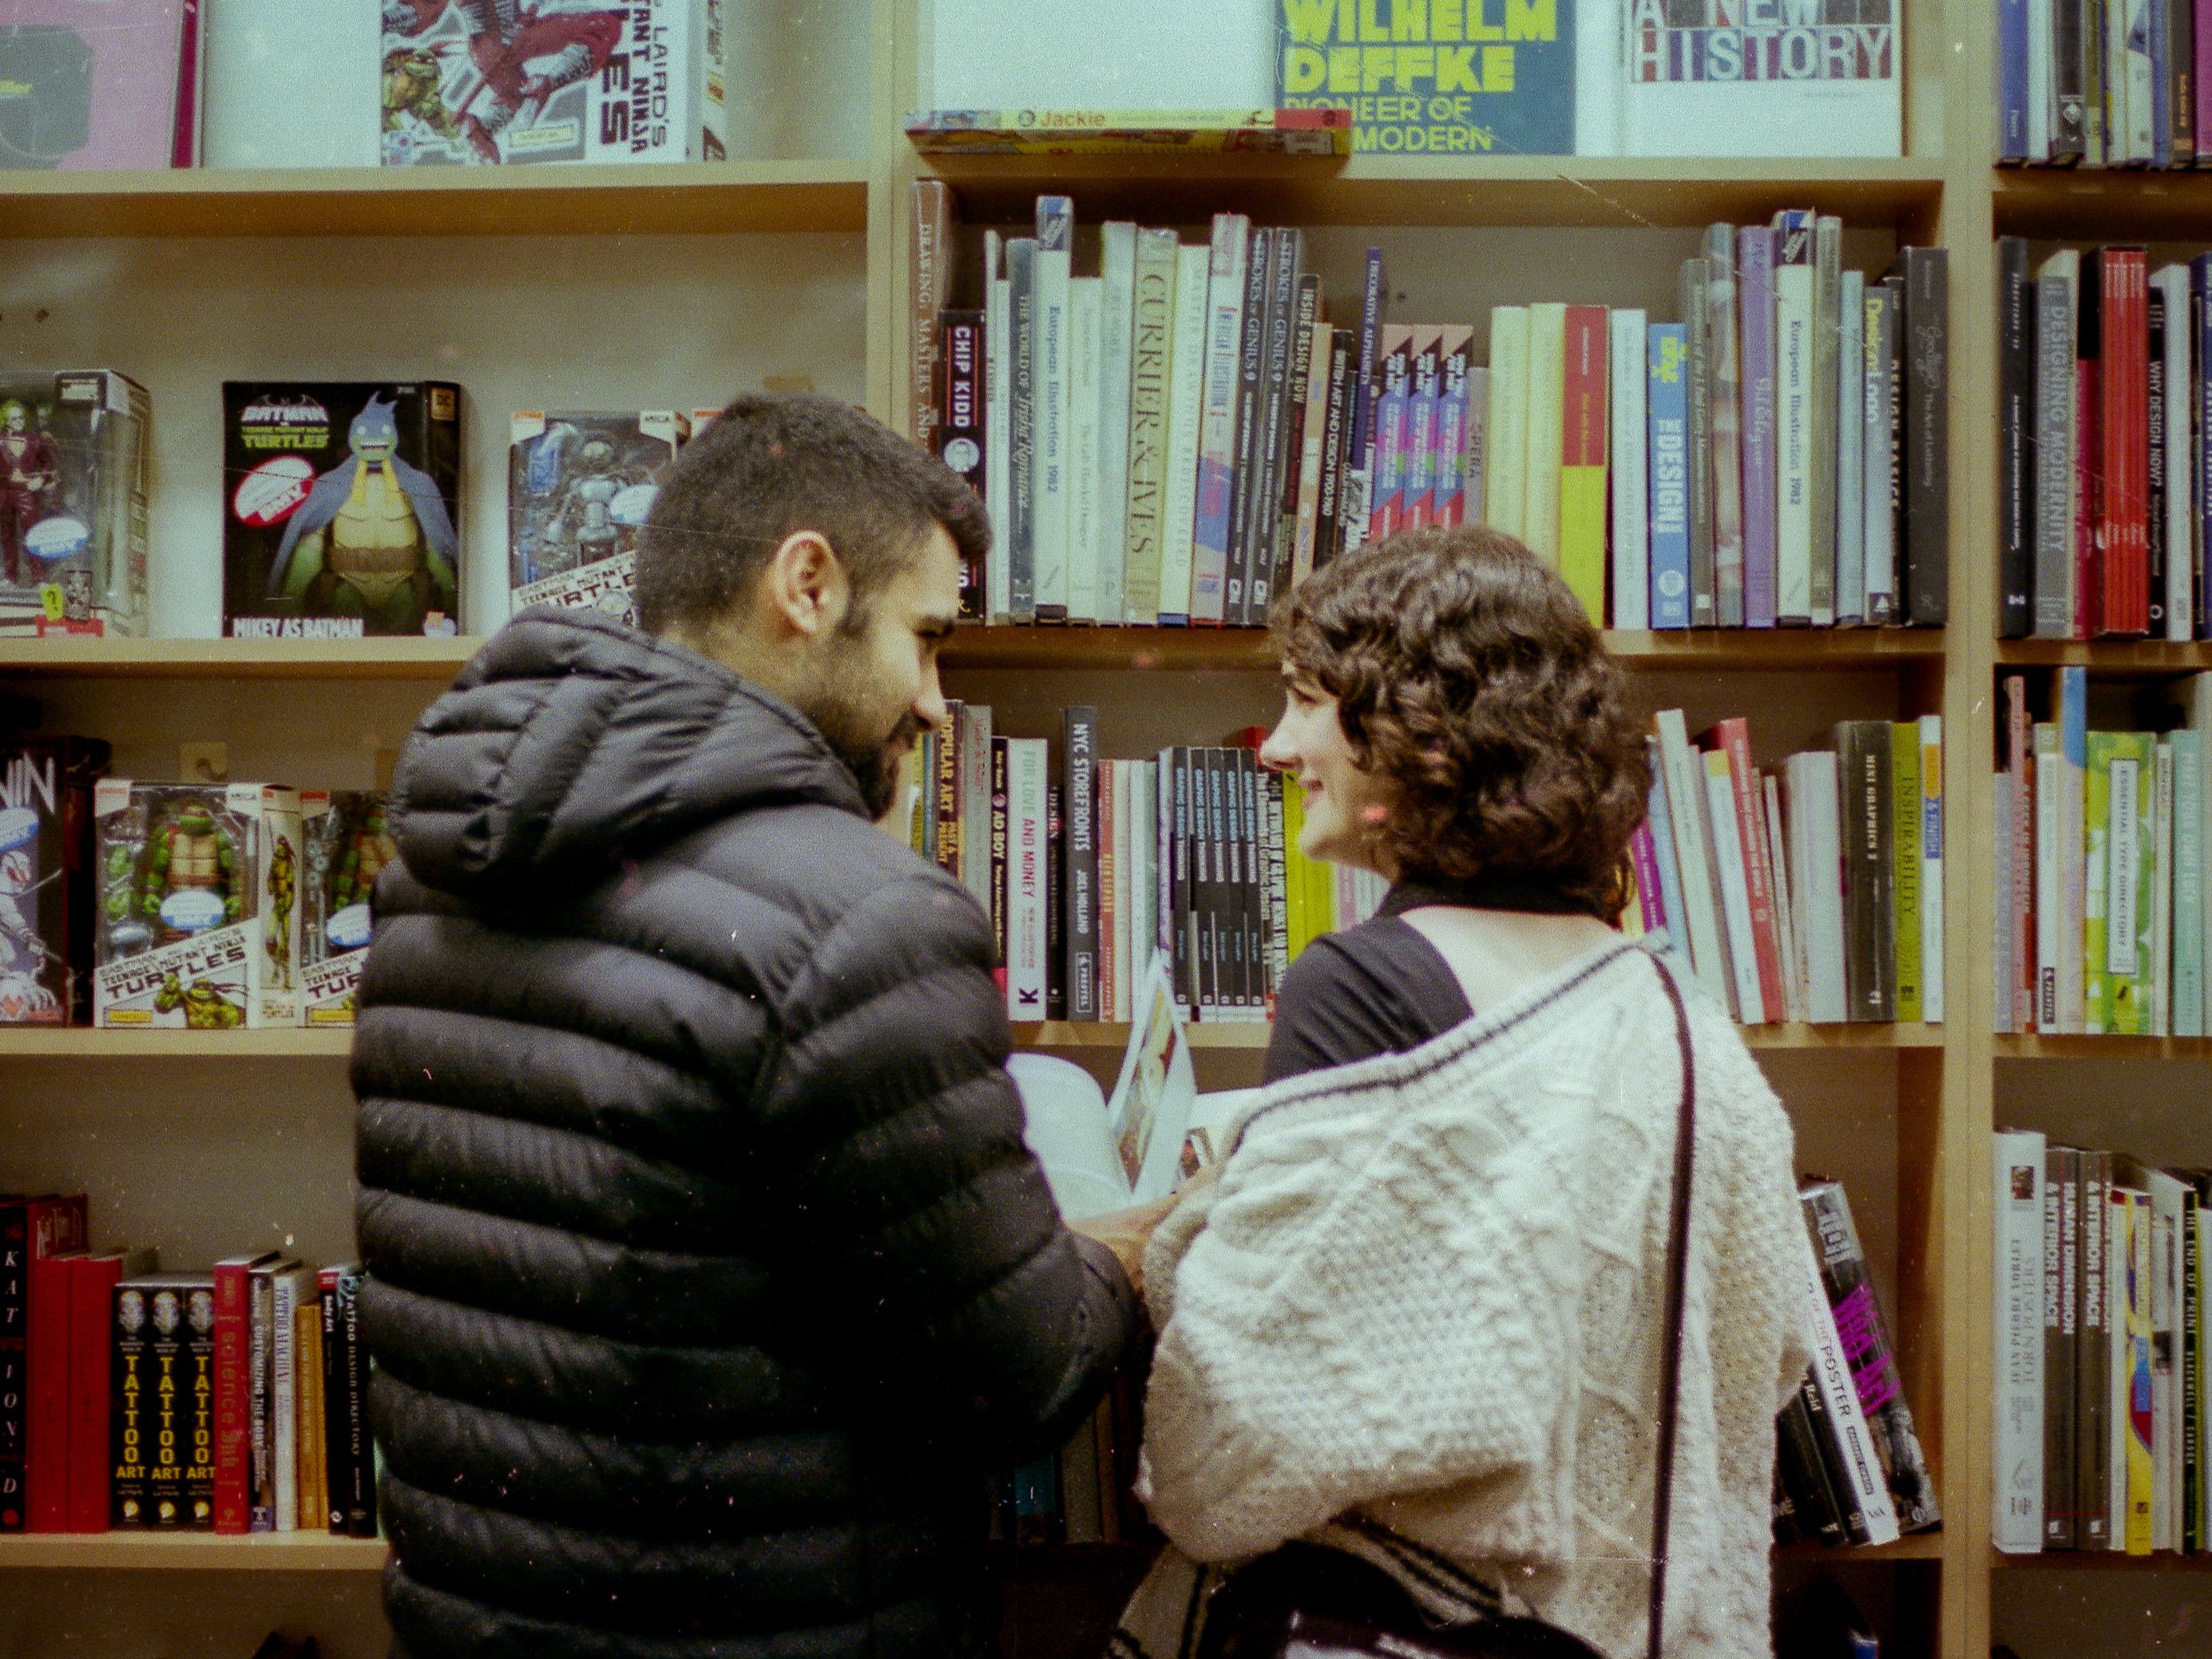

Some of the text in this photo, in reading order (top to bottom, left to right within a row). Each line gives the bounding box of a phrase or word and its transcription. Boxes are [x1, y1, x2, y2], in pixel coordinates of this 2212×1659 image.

[1284, 0, 1556, 42] WILHELM
[1284, 46, 1515, 93] DEFFKE
[1633, 28, 1892, 81] HISTORY
[1040, 111, 1106, 128] Jackie
[1428, 96, 1472, 122] OF
[1353, 125, 1493, 152] MODERN
[1249, 240, 1264, 301] STROKES
[1277, 241, 1292, 302] STROKES
[1018, 295, 1029, 319] THE
[1360, 259, 1380, 386] DECORATIVE ALPHABETS
[918, 319, 931, 394] MASTERS
[1017, 323, 1029, 369] WORLD
[1045, 306, 1061, 374] European
[1244, 318, 1259, 370] GENIUS
[1271, 319, 1286, 370] GENIUS
[1293, 288, 1314, 403] INSIDE DESIGN NOW
[1790, 320, 1802, 388] European
[954, 326, 971, 427] CHIP KIDD
[1017, 371, 1029, 388] OF
[1243, 370, 1256, 382] 9
[1270, 372, 1282, 382] 9
[1330, 386, 1342, 407] ART
[1047, 381, 1060, 458] Illustration
[1130, 273, 1166, 554] CURRIER & IVES
[1328, 408, 1341, 432] AND
[2048, 305, 2067, 553] DESIGNING MODERNITY
[2149, 361, 2162, 486] WHY DESIGN NOW?
[1326, 432, 1338, 470] DESIGN
[1656, 434, 1684, 520] DESIGN
[939, 712, 953, 813] POPULAR ART
[1021, 750, 1036, 778] FOR
[1072, 723, 1091, 852] NYC STOREFRONTS
[1176, 767, 1185, 806] GRAPHIC
[1257, 772, 1269, 790] The
[1021, 781, 1036, 814] LOVE
[1194, 769, 1204, 808] GRAPHIC
[1210, 770, 1220, 809] GRAPHIC
[1227, 770, 1237, 809] GRAPHIC
[1243, 770, 1254, 809] GRAPHIC
[1865, 754, 1878, 849] MINI GRAPHICS
[993, 810, 1004, 860] AD BOY
[1022, 817, 1035, 848] AND
[1176, 806, 1185, 839] DESIGN
[1195, 807, 1205, 841] DESIGN
[1211, 808, 1222, 841] DESIGN
[1228, 809, 1238, 842] DESIGN
[1245, 810, 1255, 842] DESIGN
[1901, 776, 1917, 917] INSPIRABILITY
[1021, 849, 1035, 898] MONEY
[2118, 770, 2128, 947] ESSENTIAL TYPE DIRECTORY
[1076, 892, 1089, 935] HOLLAND
[2044, 1197, 2059, 1271] INTERIOR
[2087, 1195, 2101, 1271] INTERIOR
[2063, 1182, 2075, 1335] HUMAN DIMENSION
[2186, 1210, 2196, 1336] THE END OF PRINT
[323, 1295, 335, 1332] Body Art
[2044, 1275, 2059, 1326] SPACE
[2087, 1274, 2101, 1326] SPACE
[220, 1330, 236, 1425] science
[252, 1324, 264, 1395] CUSTOMIZING
[346, 1295, 361, 1457] TATTOO DESIGN DIRECTORY
[1820, 1344, 1852, 1418] POSTER
[123, 1355, 140, 1464] TATTOO
[159, 1356, 175, 1466] TATTOO
[194, 1355, 211, 1465] TATTOO
[253, 1398, 264, 1417] THE
[2185, 1351, 2195, 1465] BLACKWELL CARSON
[253, 1419, 264, 1447] BODY
[115, 1465, 146, 1479] ART
[151, 1467, 182, 1480] ART
[185, 1466, 216, 1479] ART
